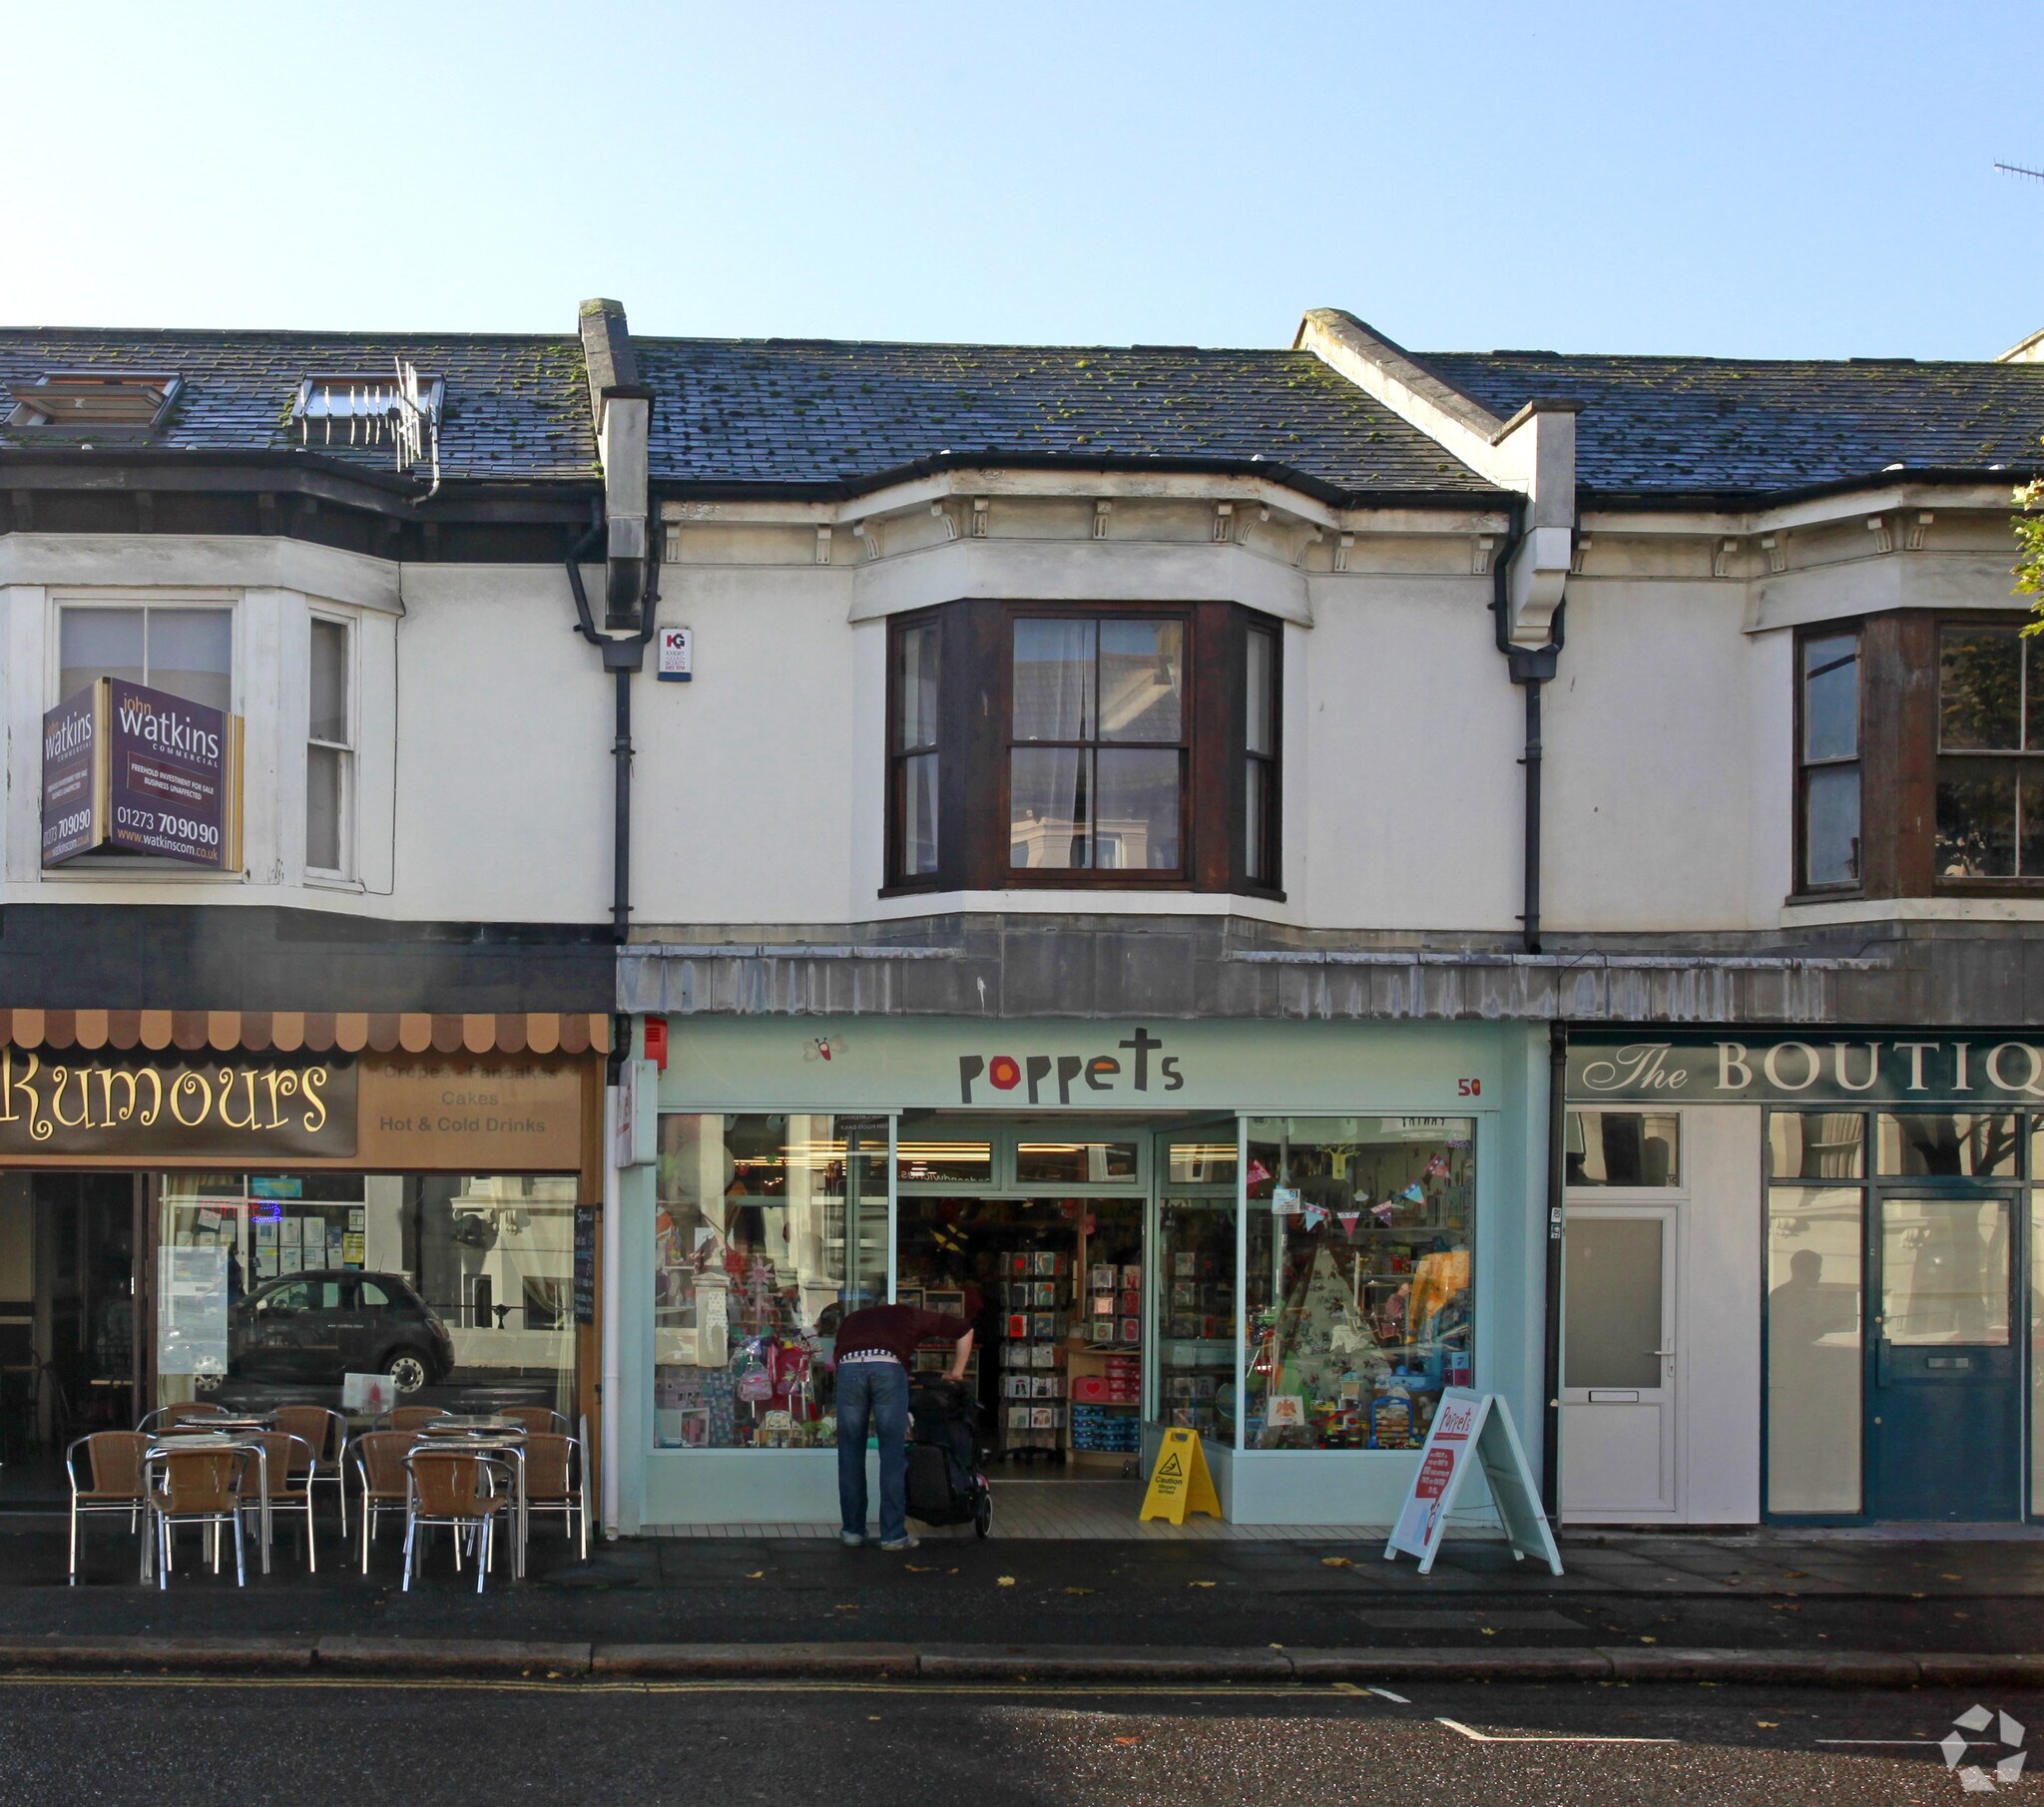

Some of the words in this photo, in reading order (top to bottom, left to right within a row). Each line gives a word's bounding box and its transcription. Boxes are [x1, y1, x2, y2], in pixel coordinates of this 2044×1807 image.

[153, 743, 219, 768] COMMERCIAL
[131, 762, 160, 778] FREEHOLD
[160, 770, 192, 788] INVESTMENT
[192, 781, 202, 791] FOR
[202, 784, 215, 795] SALE
[144, 777, 170, 791] BUSINESS
[170, 784, 203, 800] UNAFFECTED
[58, 808, 91, 839] 709090
[117, 806, 154, 830] 01273
[158, 812, 219, 845] 709090
[117, 828, 219, 861] www.watkinscom.co.uk
[1582, 1042, 1689, 1091] The
[0, 1052, 328, 1140] Rumours
[441, 1091, 499, 1106] Cakes
[1458, 1079, 1481, 1097] 50
[379, 1117, 412, 1131] Hot
[418, 1117, 432, 1131] &
[437, 1117, 479, 1131] Cold
[486, 1117, 546, 1132] Drinks
[1155, 1476, 1183, 1485] Caution
